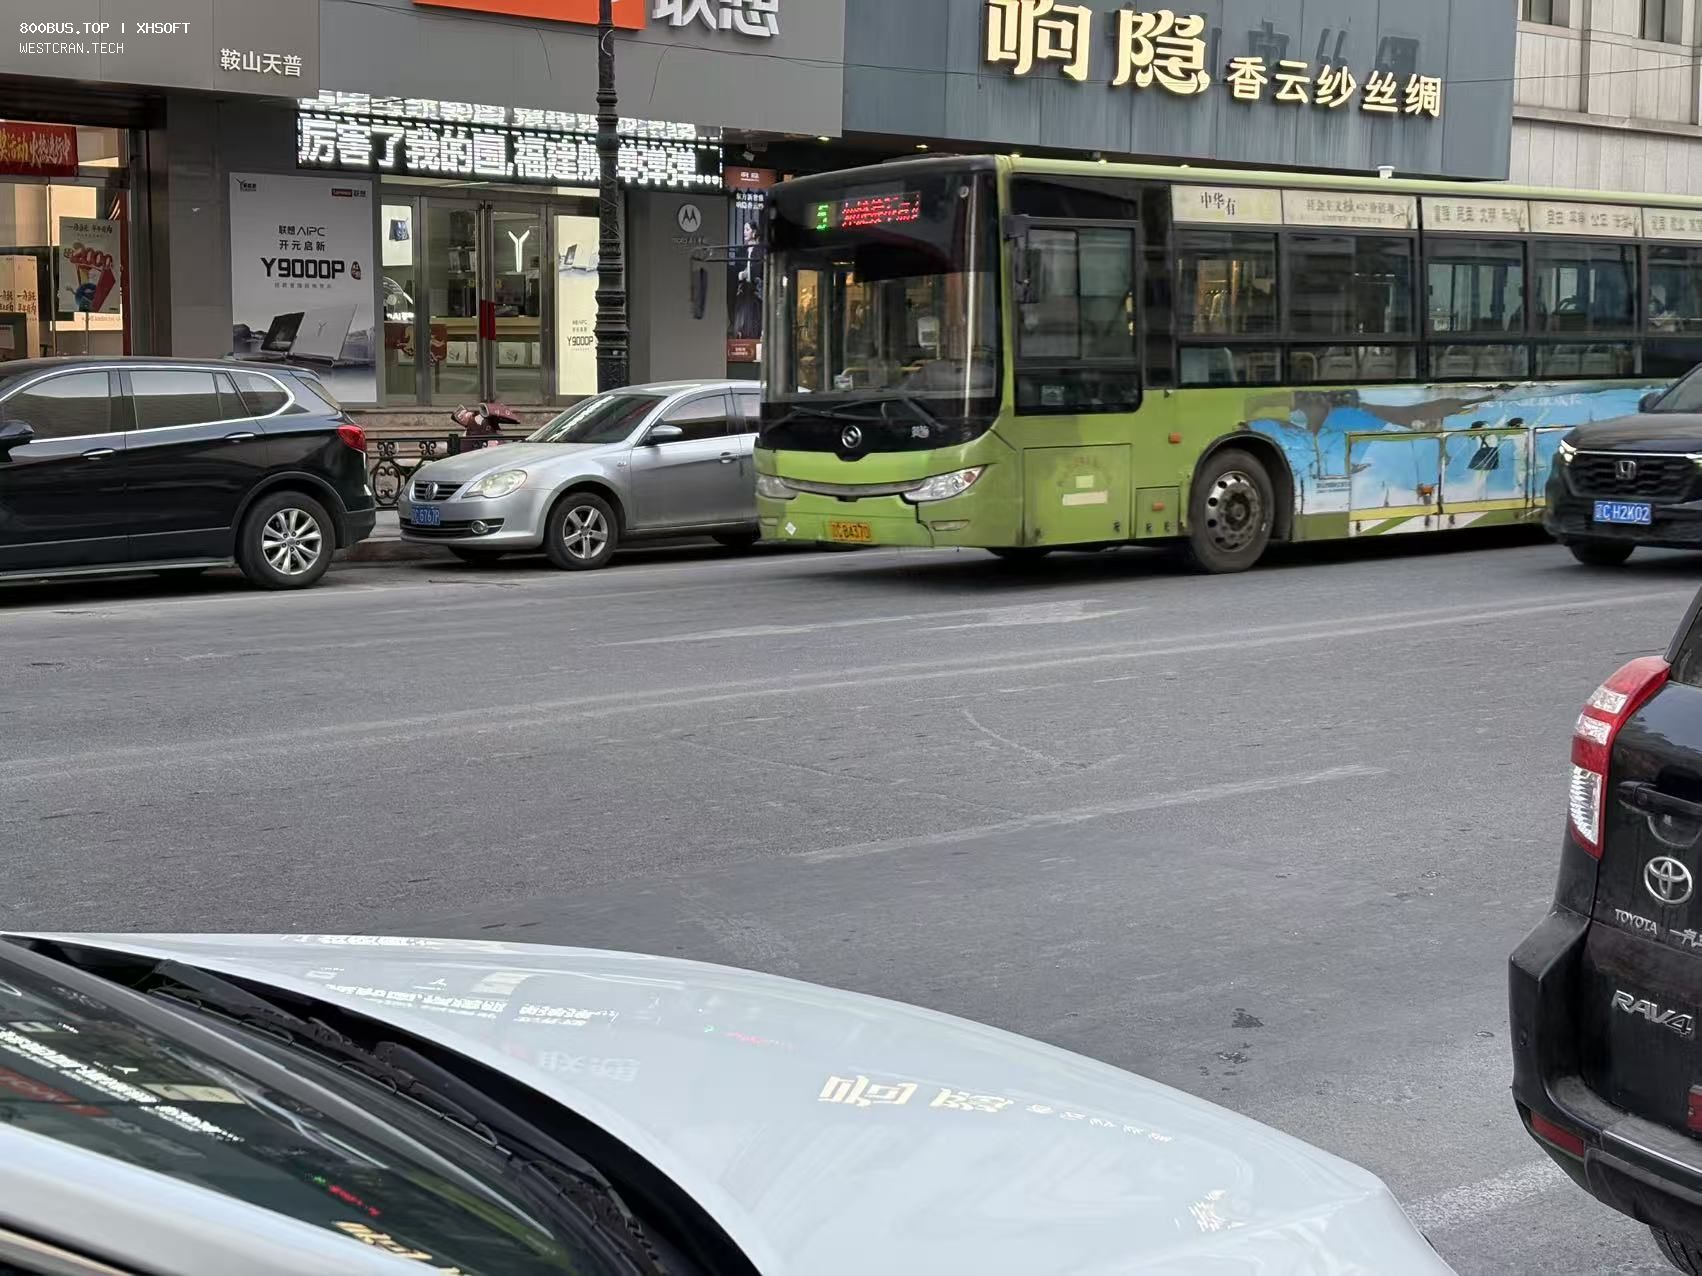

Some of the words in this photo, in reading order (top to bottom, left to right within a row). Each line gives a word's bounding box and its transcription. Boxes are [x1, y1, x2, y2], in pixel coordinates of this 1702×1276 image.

[220, 48, 302, 77] 鞍山天普
[1227, 56, 1442, 117] 香云纱丝绸
[279, 239, 326, 252] 开元启新
[261, 257, 345, 279] Y9000P
[1615, 908, 1657, 935] TOYOTA
[1669, 928, 1702, 948] 一汽
[1611, 989, 1695, 1040] RAV4
